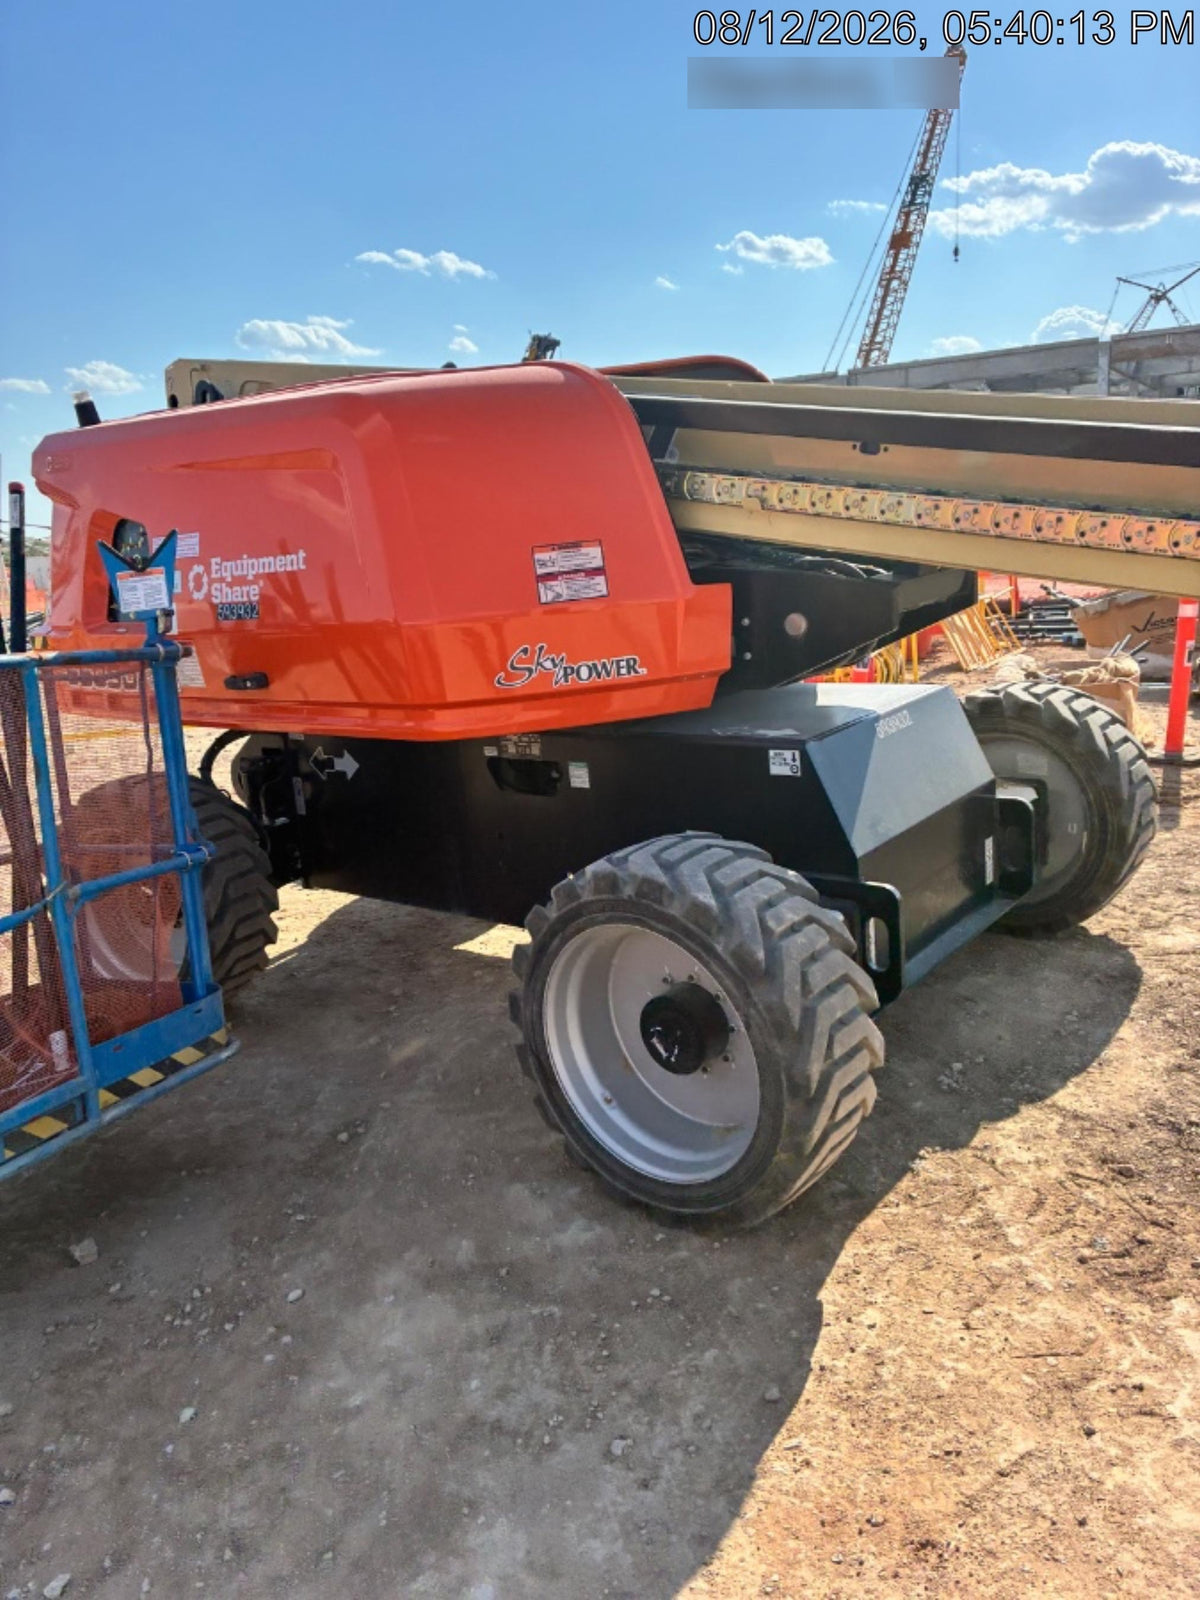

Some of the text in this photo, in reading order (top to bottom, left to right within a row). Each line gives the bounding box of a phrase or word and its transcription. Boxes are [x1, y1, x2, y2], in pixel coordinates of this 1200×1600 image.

[210, 549, 306, 582] Equipment
[210, 582, 260, 604] Share
[217, 603, 259, 620] 593932
